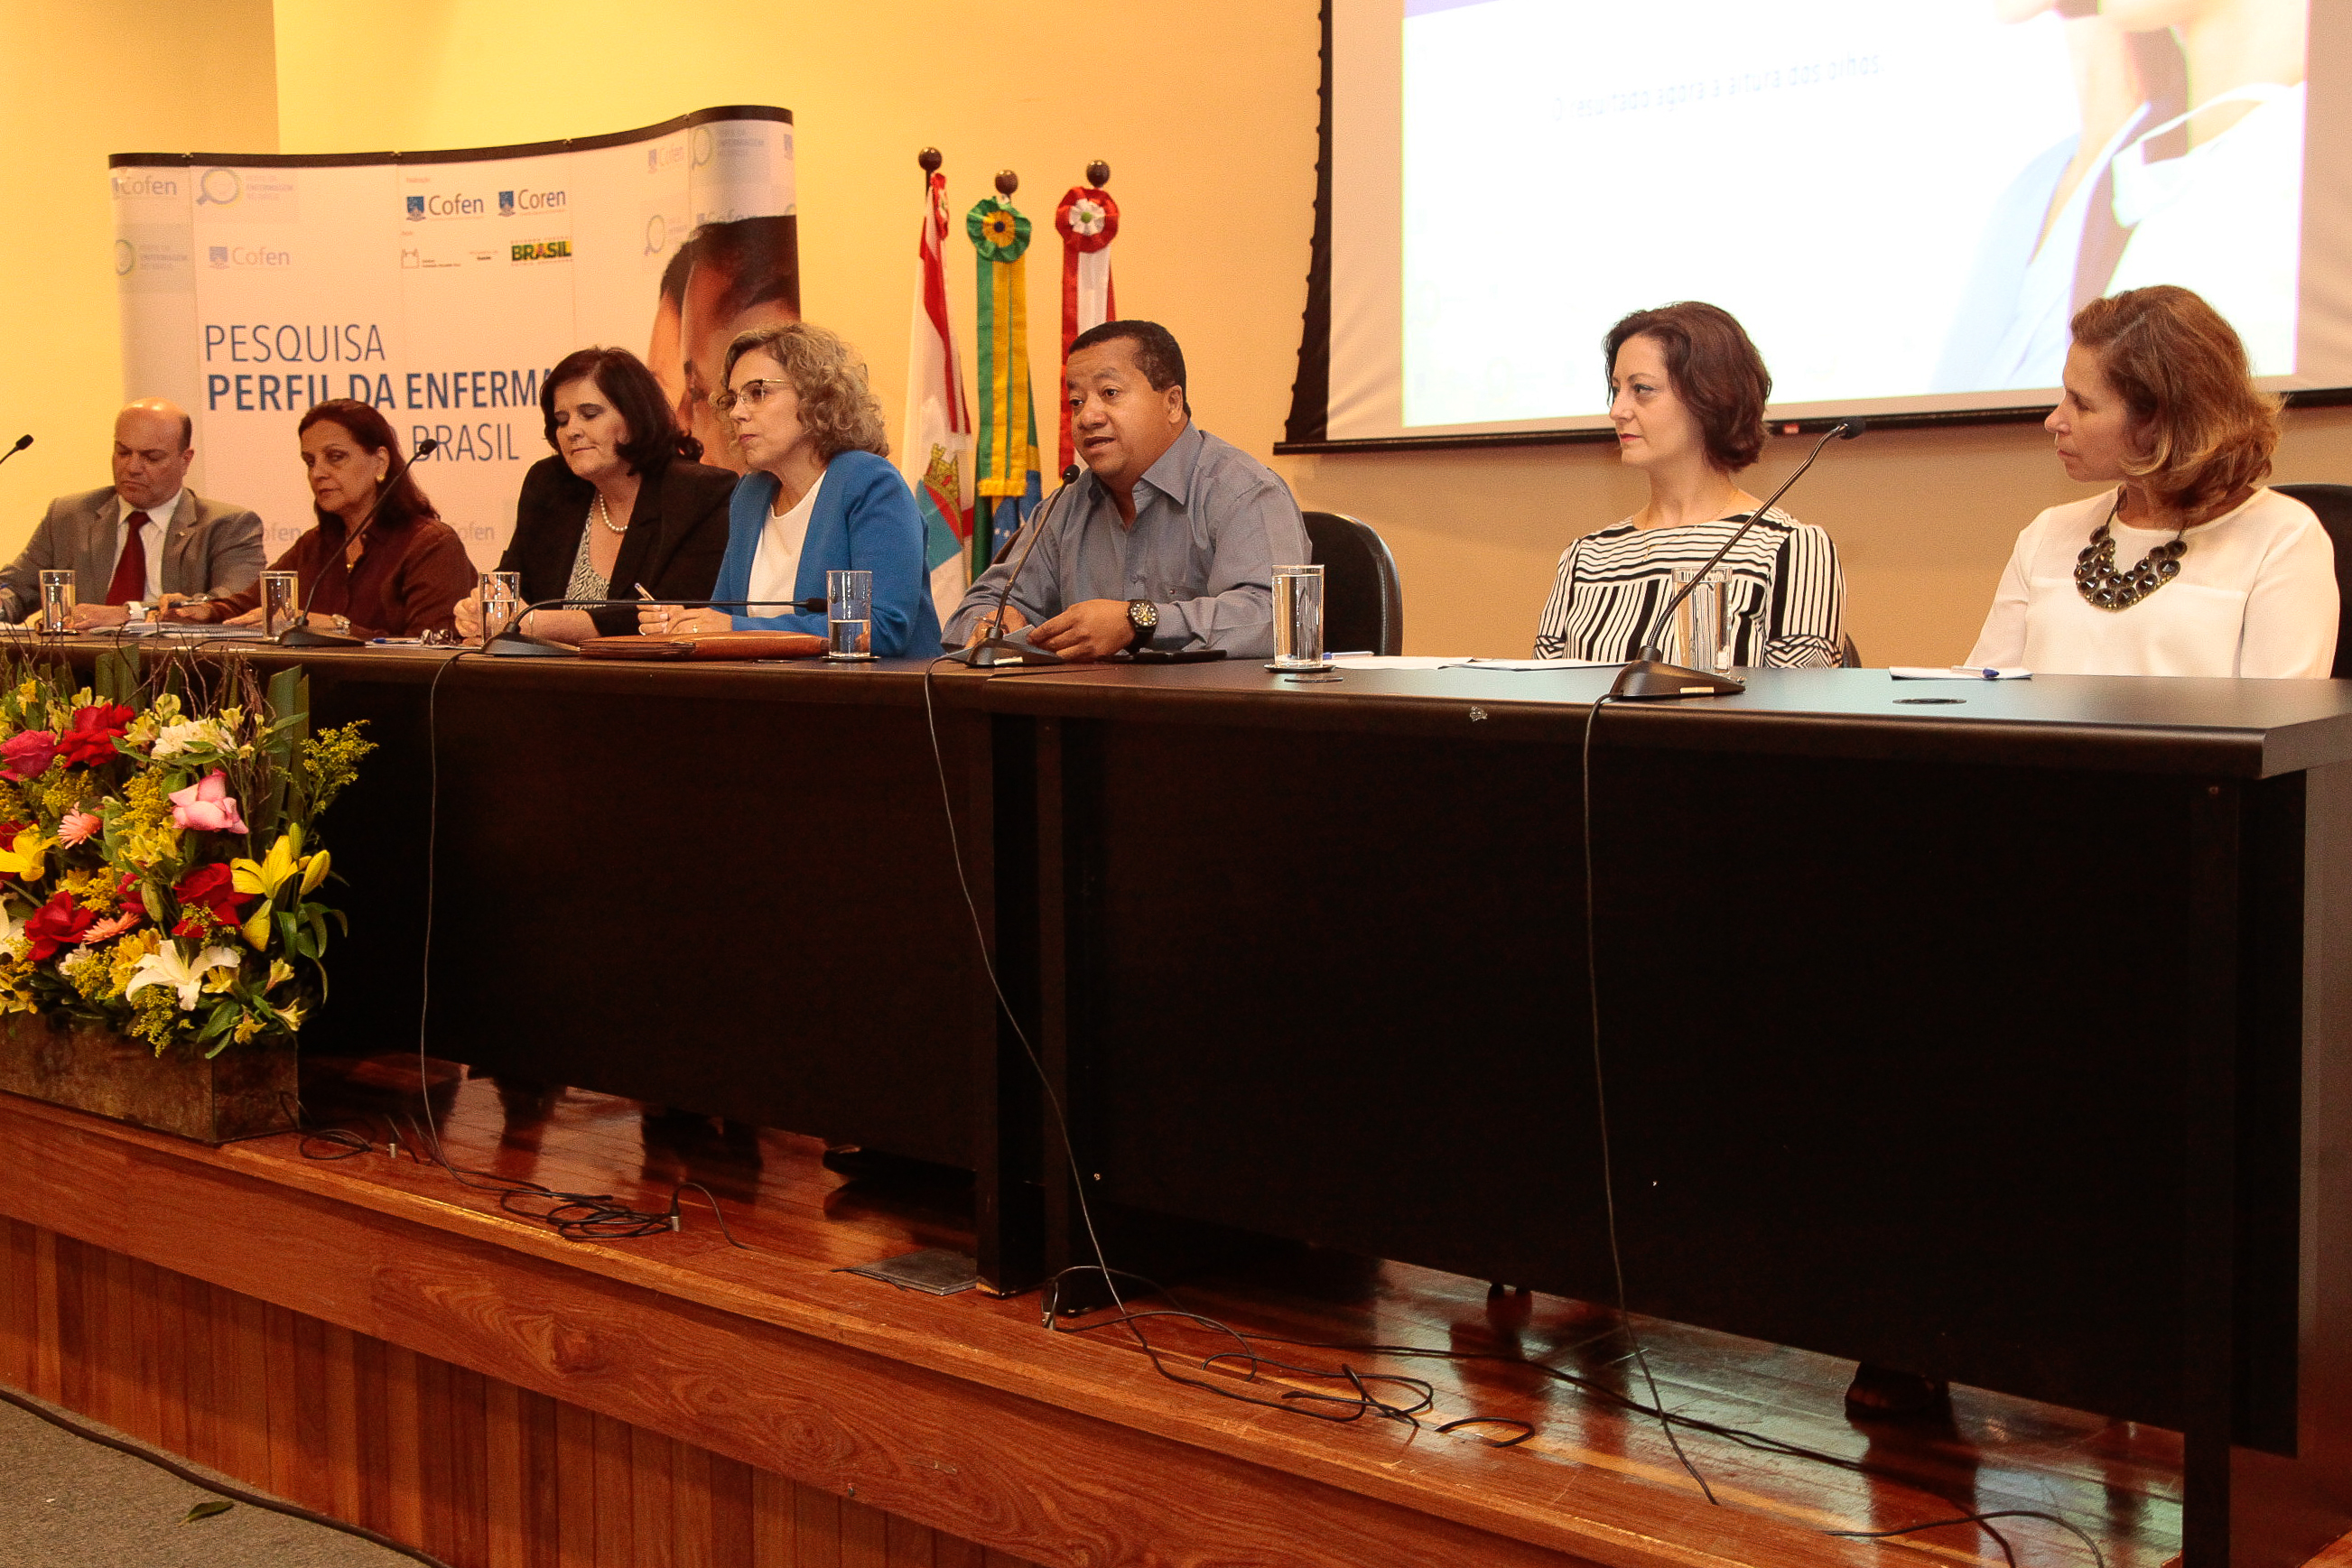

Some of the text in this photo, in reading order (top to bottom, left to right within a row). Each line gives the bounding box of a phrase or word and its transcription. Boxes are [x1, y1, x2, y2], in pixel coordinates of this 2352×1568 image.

[120, 174, 177, 196] Cofen
[428, 192, 485, 216] Cofen
[517, 189, 567, 210] Coren
[231, 246, 291, 266] Cofen
[510, 240, 572, 262] BRASIL
[205, 323, 386, 363] PESQUISA
[208, 368, 552, 411] PERFIL DA ENFERM
[413, 422, 520, 461] BRASIL
[264, 521, 302, 543] ofen
[456, 520, 496, 542] ofen
